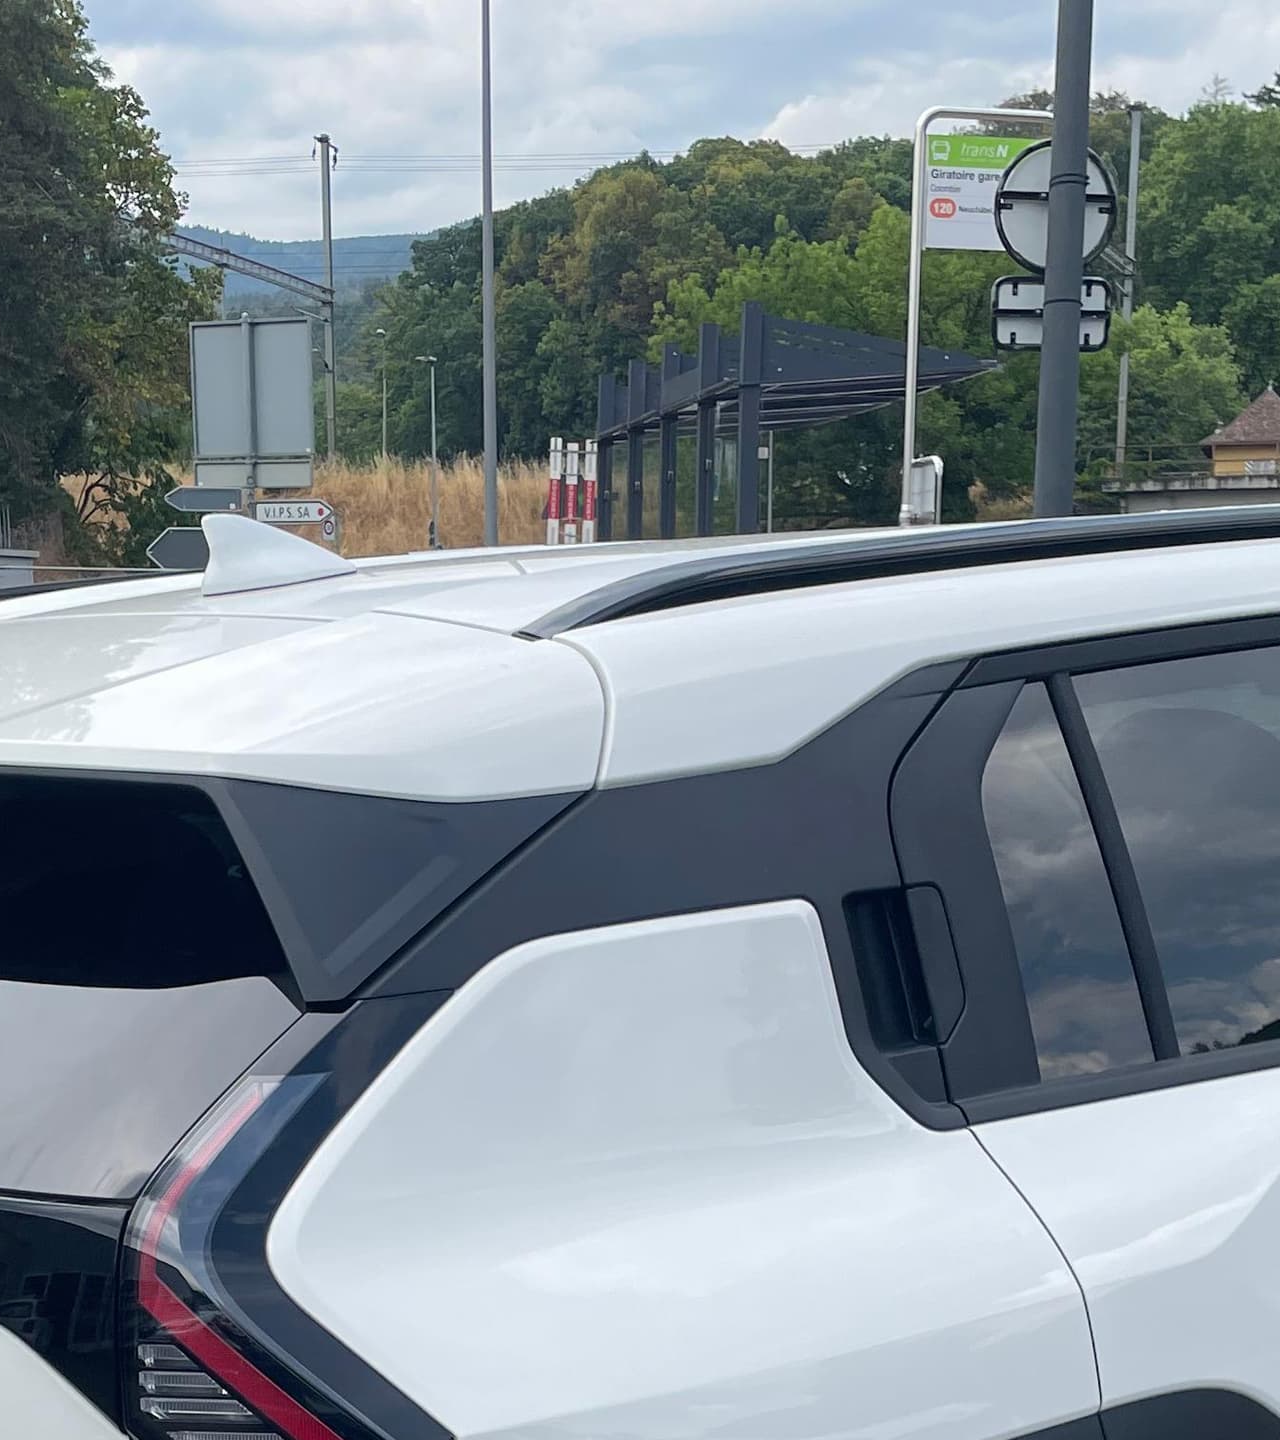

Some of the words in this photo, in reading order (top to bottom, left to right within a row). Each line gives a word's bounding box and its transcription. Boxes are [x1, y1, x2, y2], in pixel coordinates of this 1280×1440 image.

[960, 143, 1009, 158] transN
[931, 168, 975, 181] Giratoire
[934, 202, 953, 214] 120
[297, 506, 311, 518] SA
